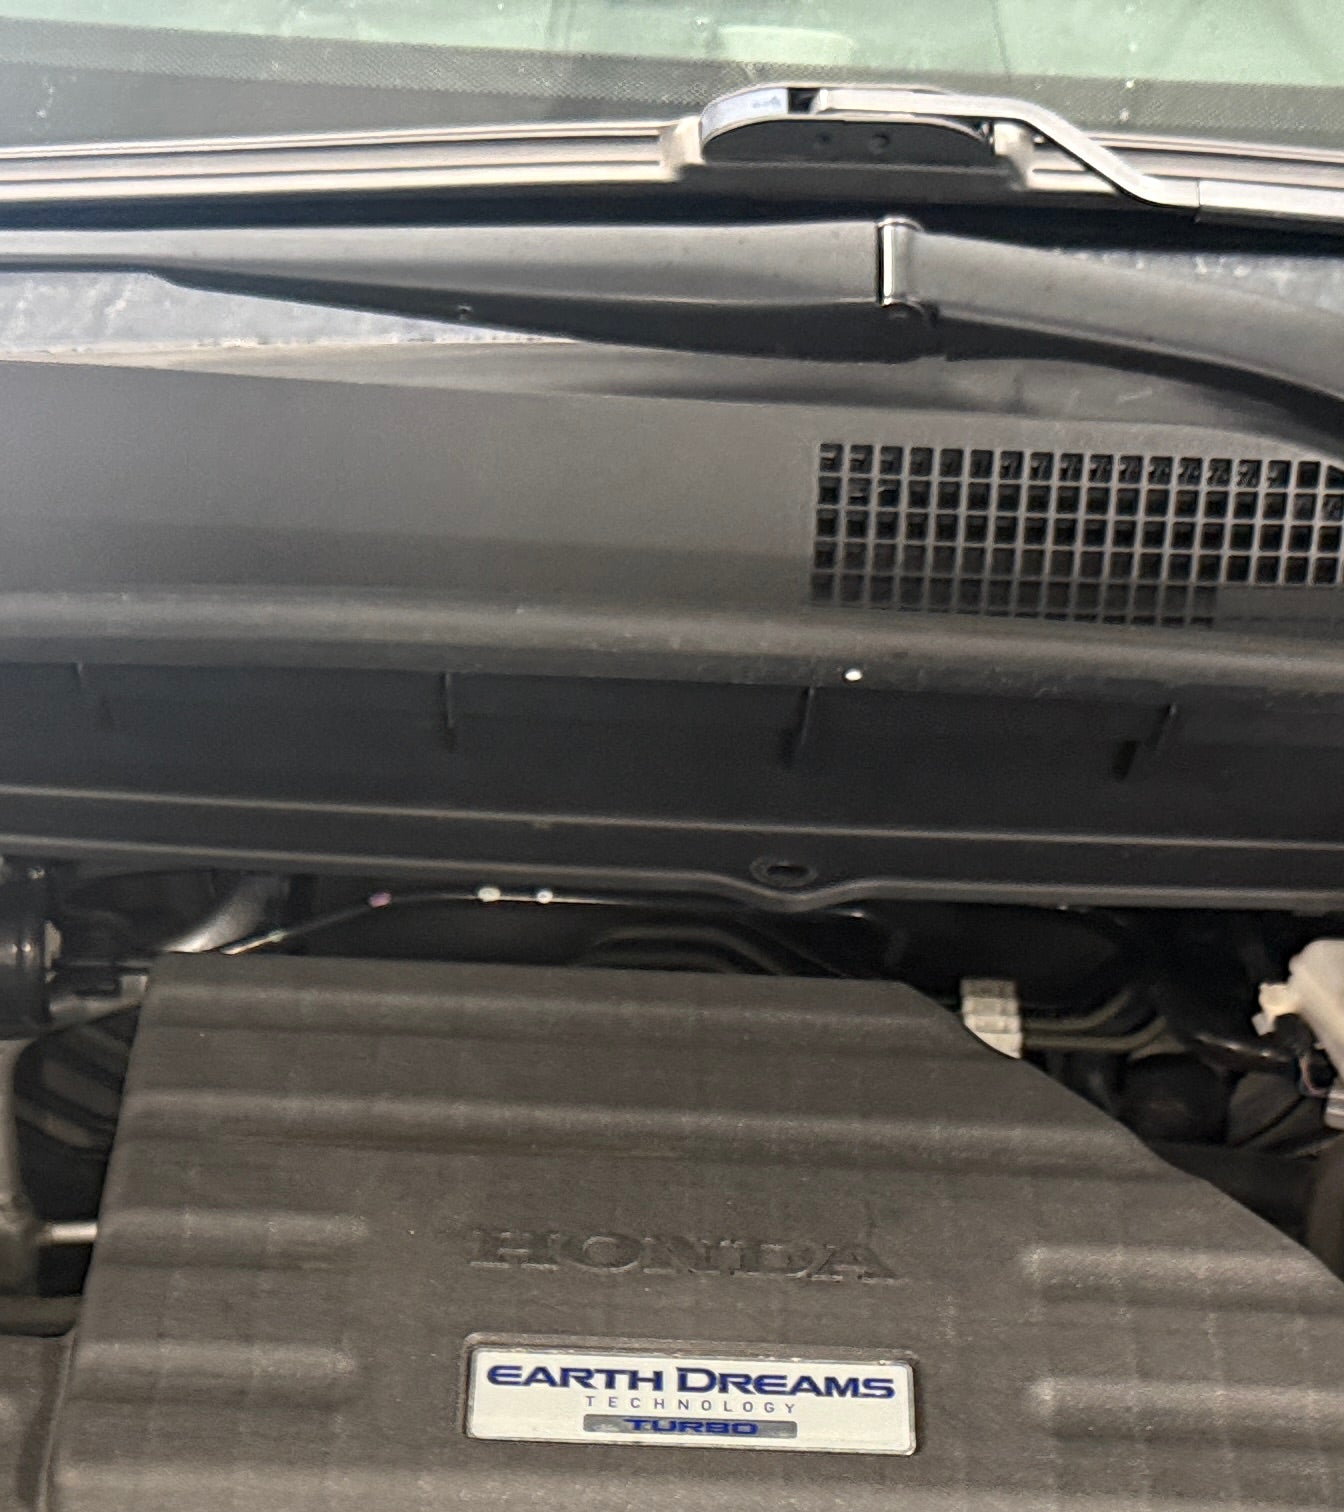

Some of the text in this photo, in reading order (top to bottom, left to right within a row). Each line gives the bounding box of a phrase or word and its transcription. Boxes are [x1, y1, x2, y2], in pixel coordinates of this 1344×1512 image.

[469, 1231, 902, 1284] HONDA
[486, 1364, 896, 1399] EARTH DREAMS
[585, 1395, 795, 1414] TECHNOLOGY
[623, 1417, 760, 1435] TURBO
